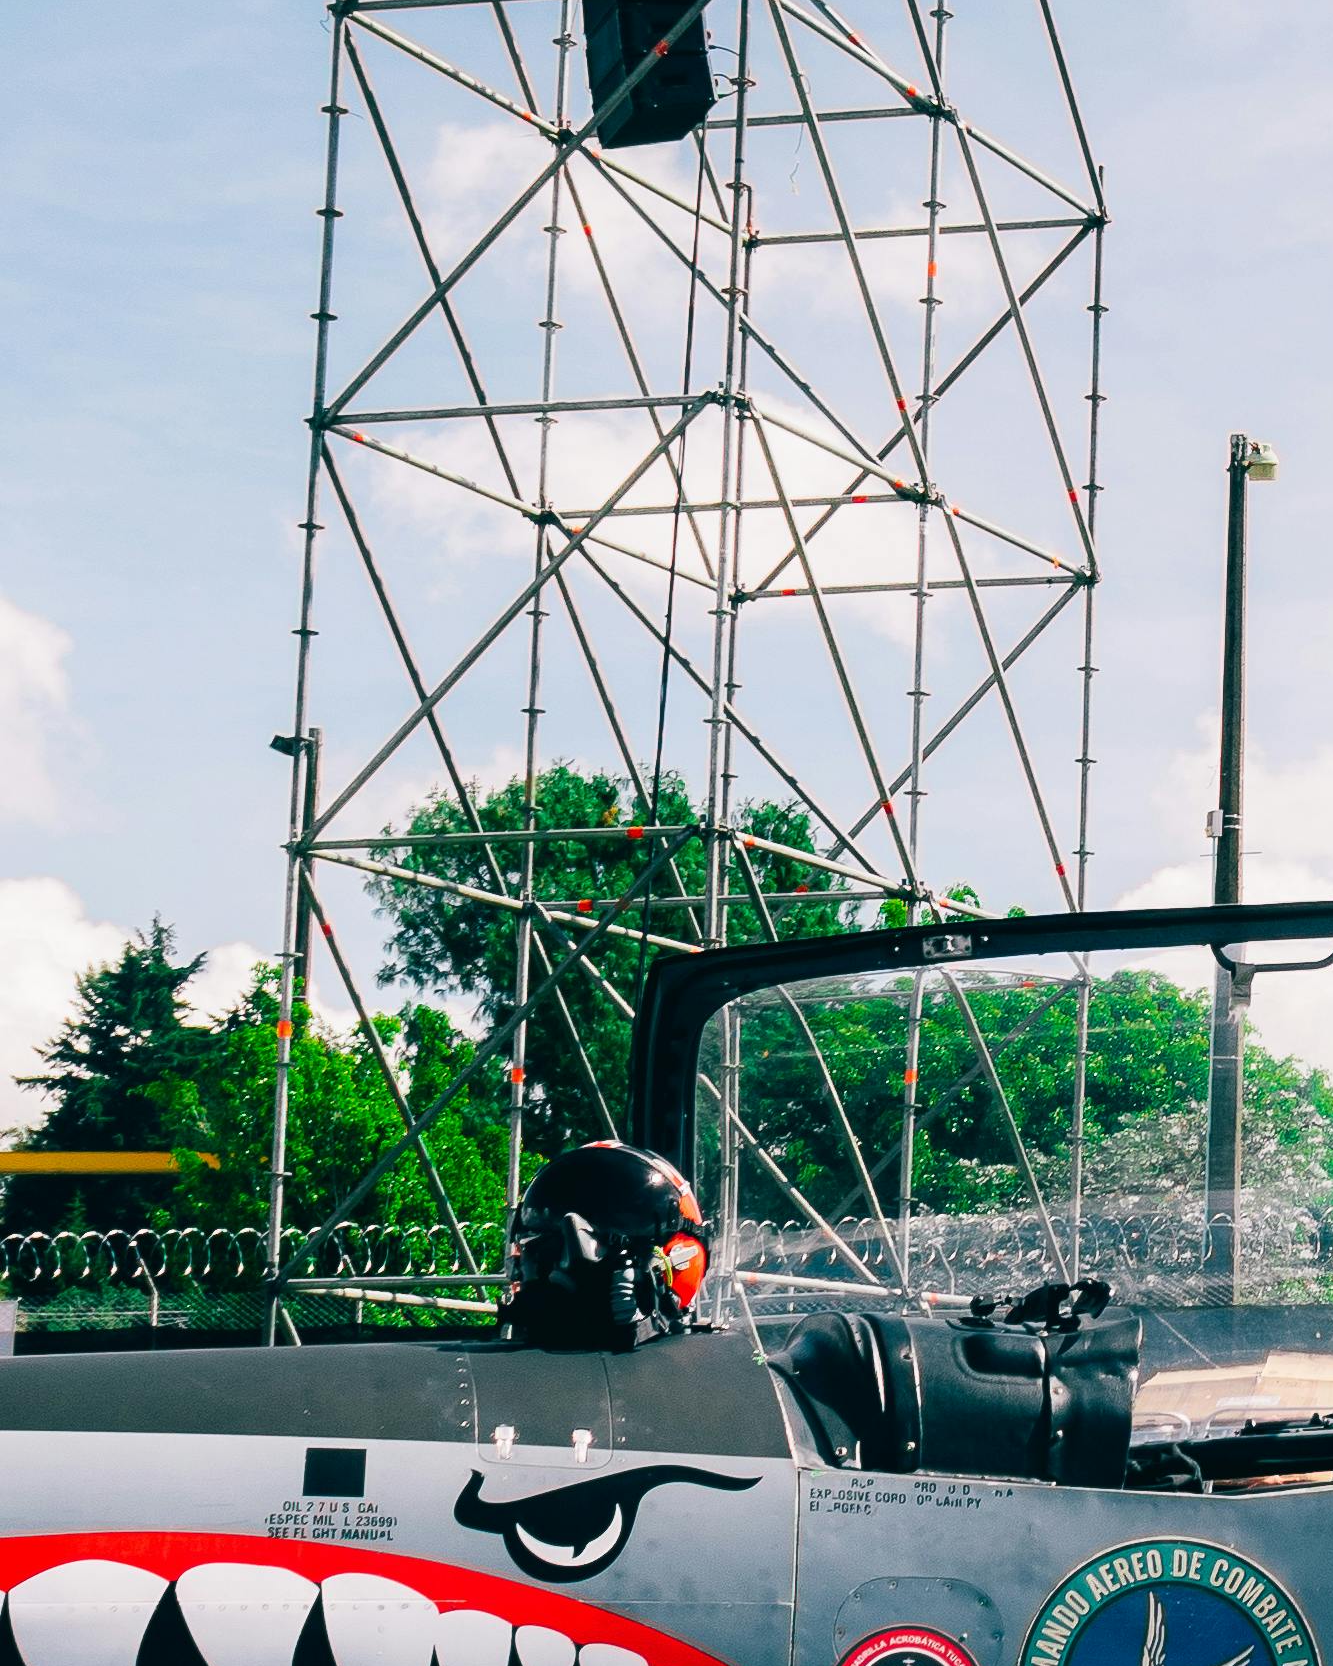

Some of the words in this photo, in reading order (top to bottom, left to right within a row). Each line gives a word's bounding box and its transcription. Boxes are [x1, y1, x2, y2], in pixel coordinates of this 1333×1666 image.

[282, 1500, 303, 1512] OIL
[312, 1515, 335, 1526] MIL
[267, 1526, 290, 1539] SEE
[293, 1527, 338, 1539] FLGHT
[1085, 1548, 1164, 1602] AEREO
[1172, 1548, 1206, 1581] DE
[1209, 1558, 1303, 1655] COMBATE
[889, 1635, 946, 1654] ACROBÁTICA
